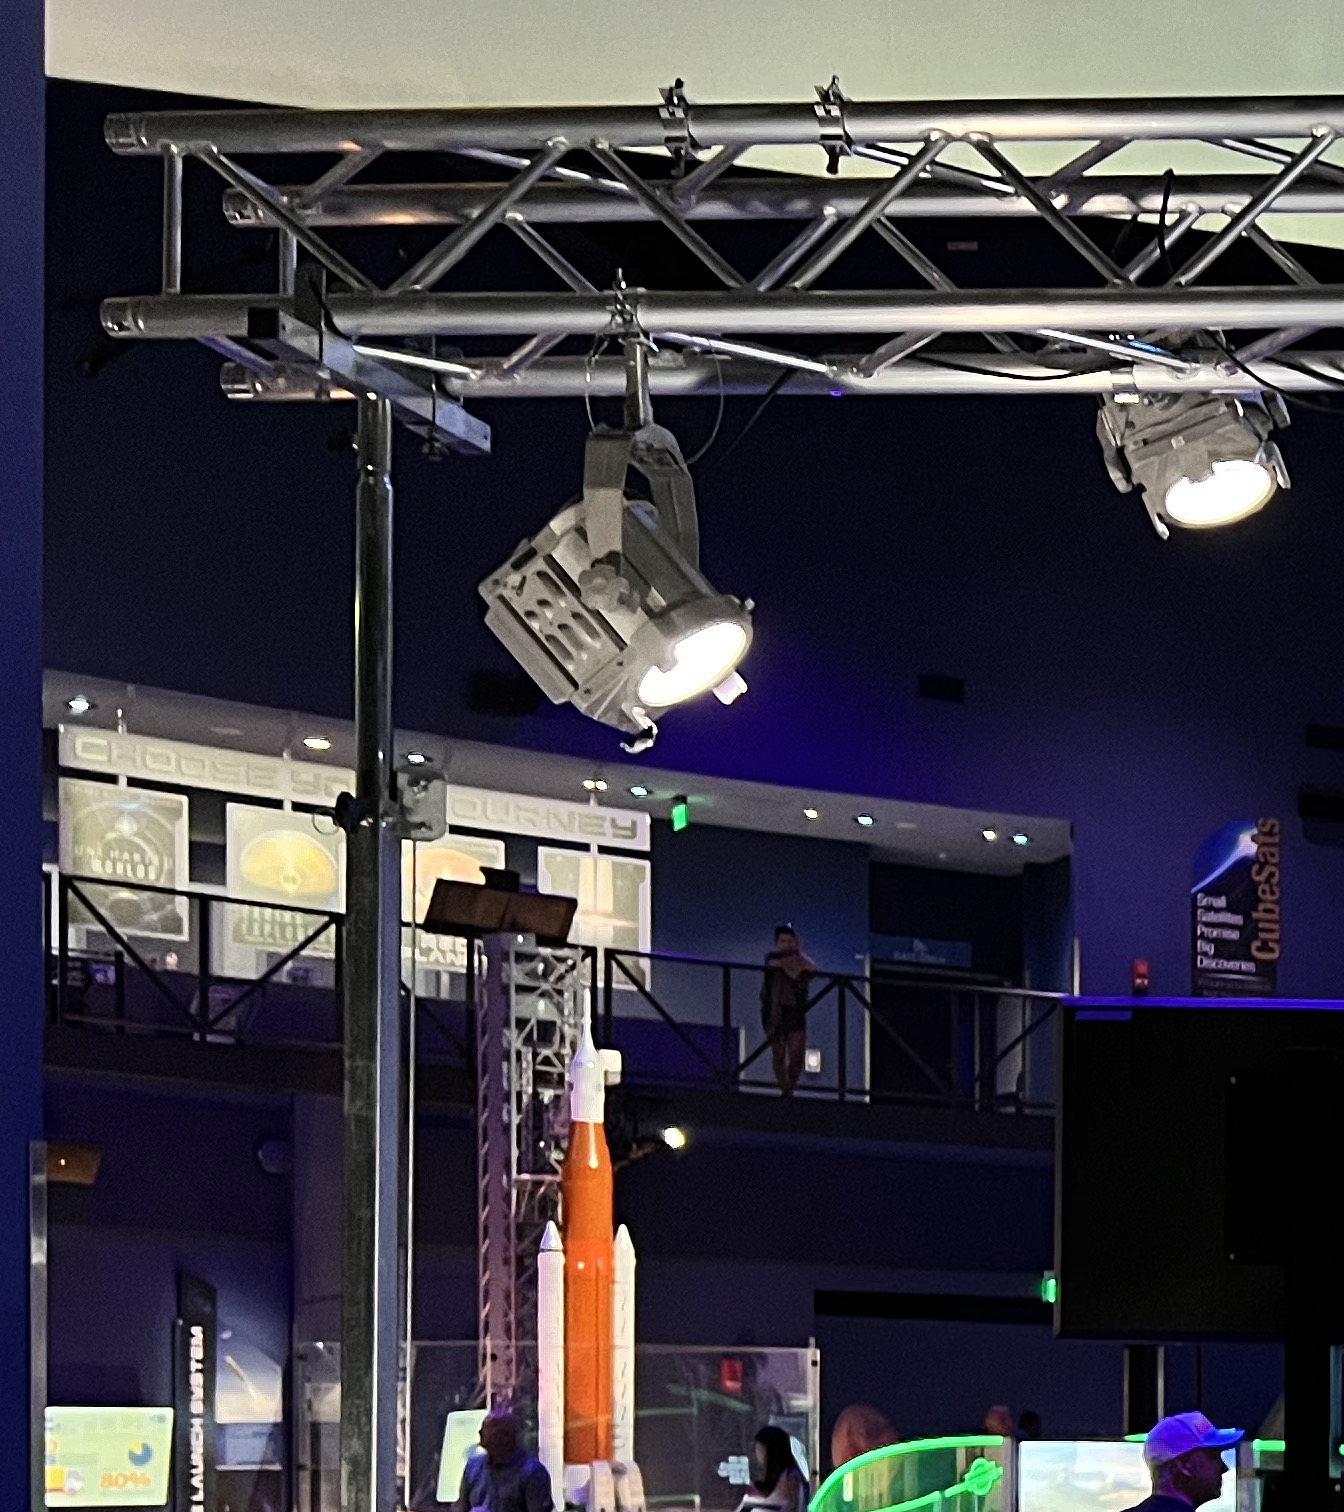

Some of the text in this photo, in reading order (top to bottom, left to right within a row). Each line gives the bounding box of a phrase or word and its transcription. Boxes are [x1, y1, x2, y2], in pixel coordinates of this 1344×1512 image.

[74, 737, 280, 788] CHOOSE
[453, 799, 638, 839] OURNEY
[1251, 817, 1279, 960] CubeSats
[1197, 938, 1215, 957] Big
[190, 1326, 204, 1414] SYSTEM
[100, 1472, 152, 1489] 80%
[190, 1417, 204, 1502] LAUNCH
